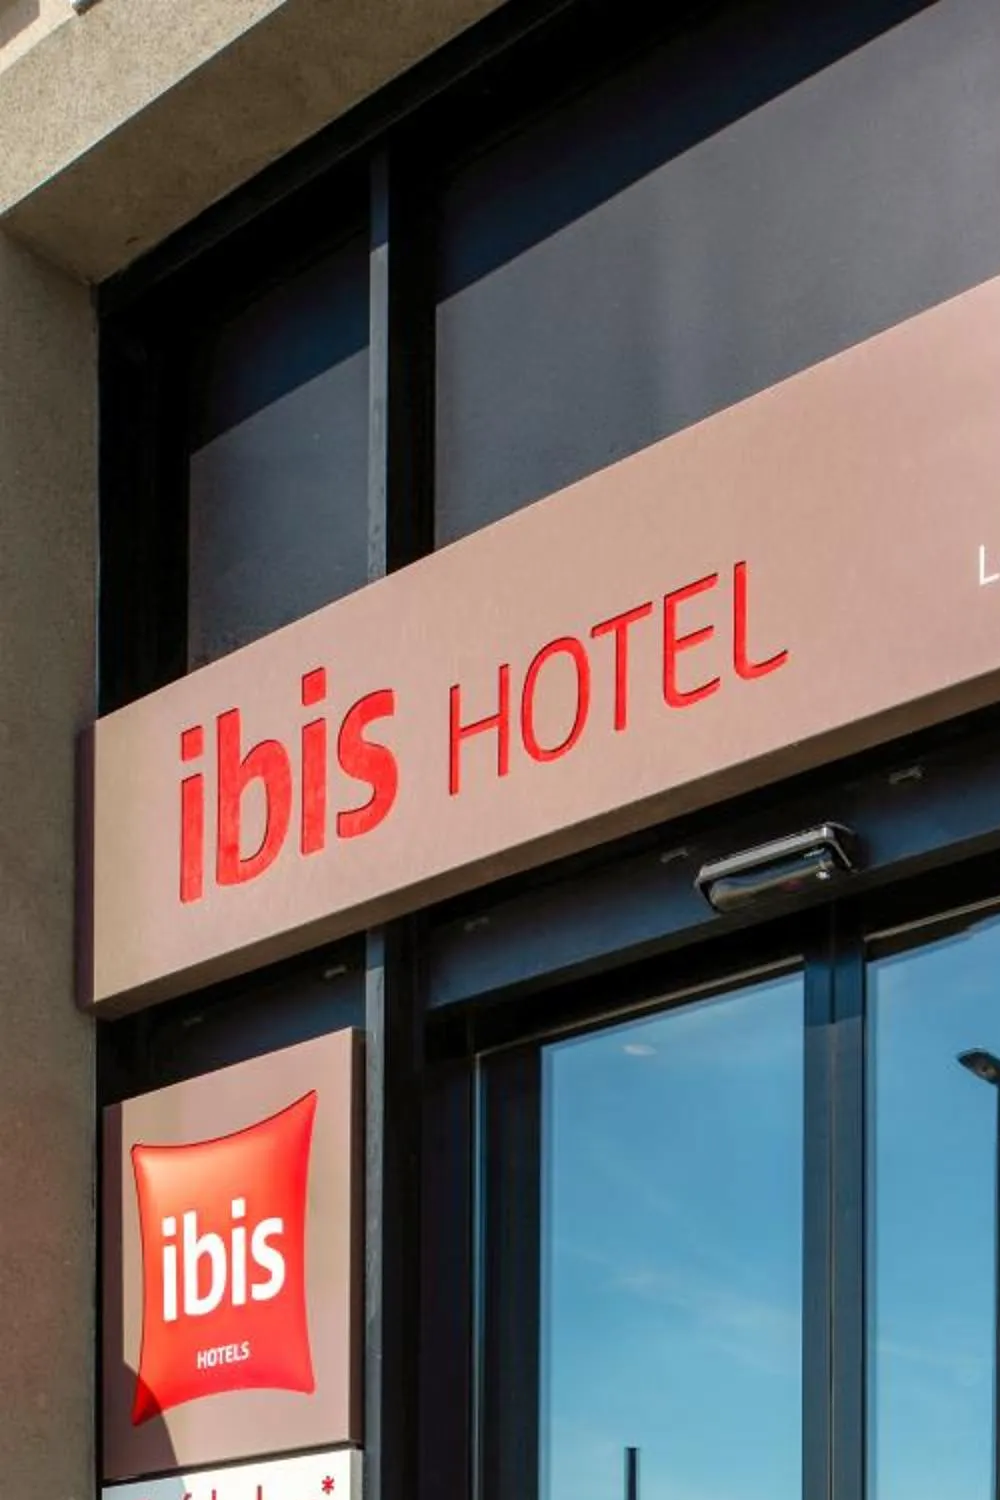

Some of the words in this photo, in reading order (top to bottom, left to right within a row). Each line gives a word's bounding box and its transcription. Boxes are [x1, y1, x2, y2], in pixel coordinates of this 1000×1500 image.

[180, 667, 398, 903] ibis
[449, 561, 788, 796] HOTEL
[162, 1197, 285, 1322] ibis
[197, 1341, 251, 1369] HOTELS
